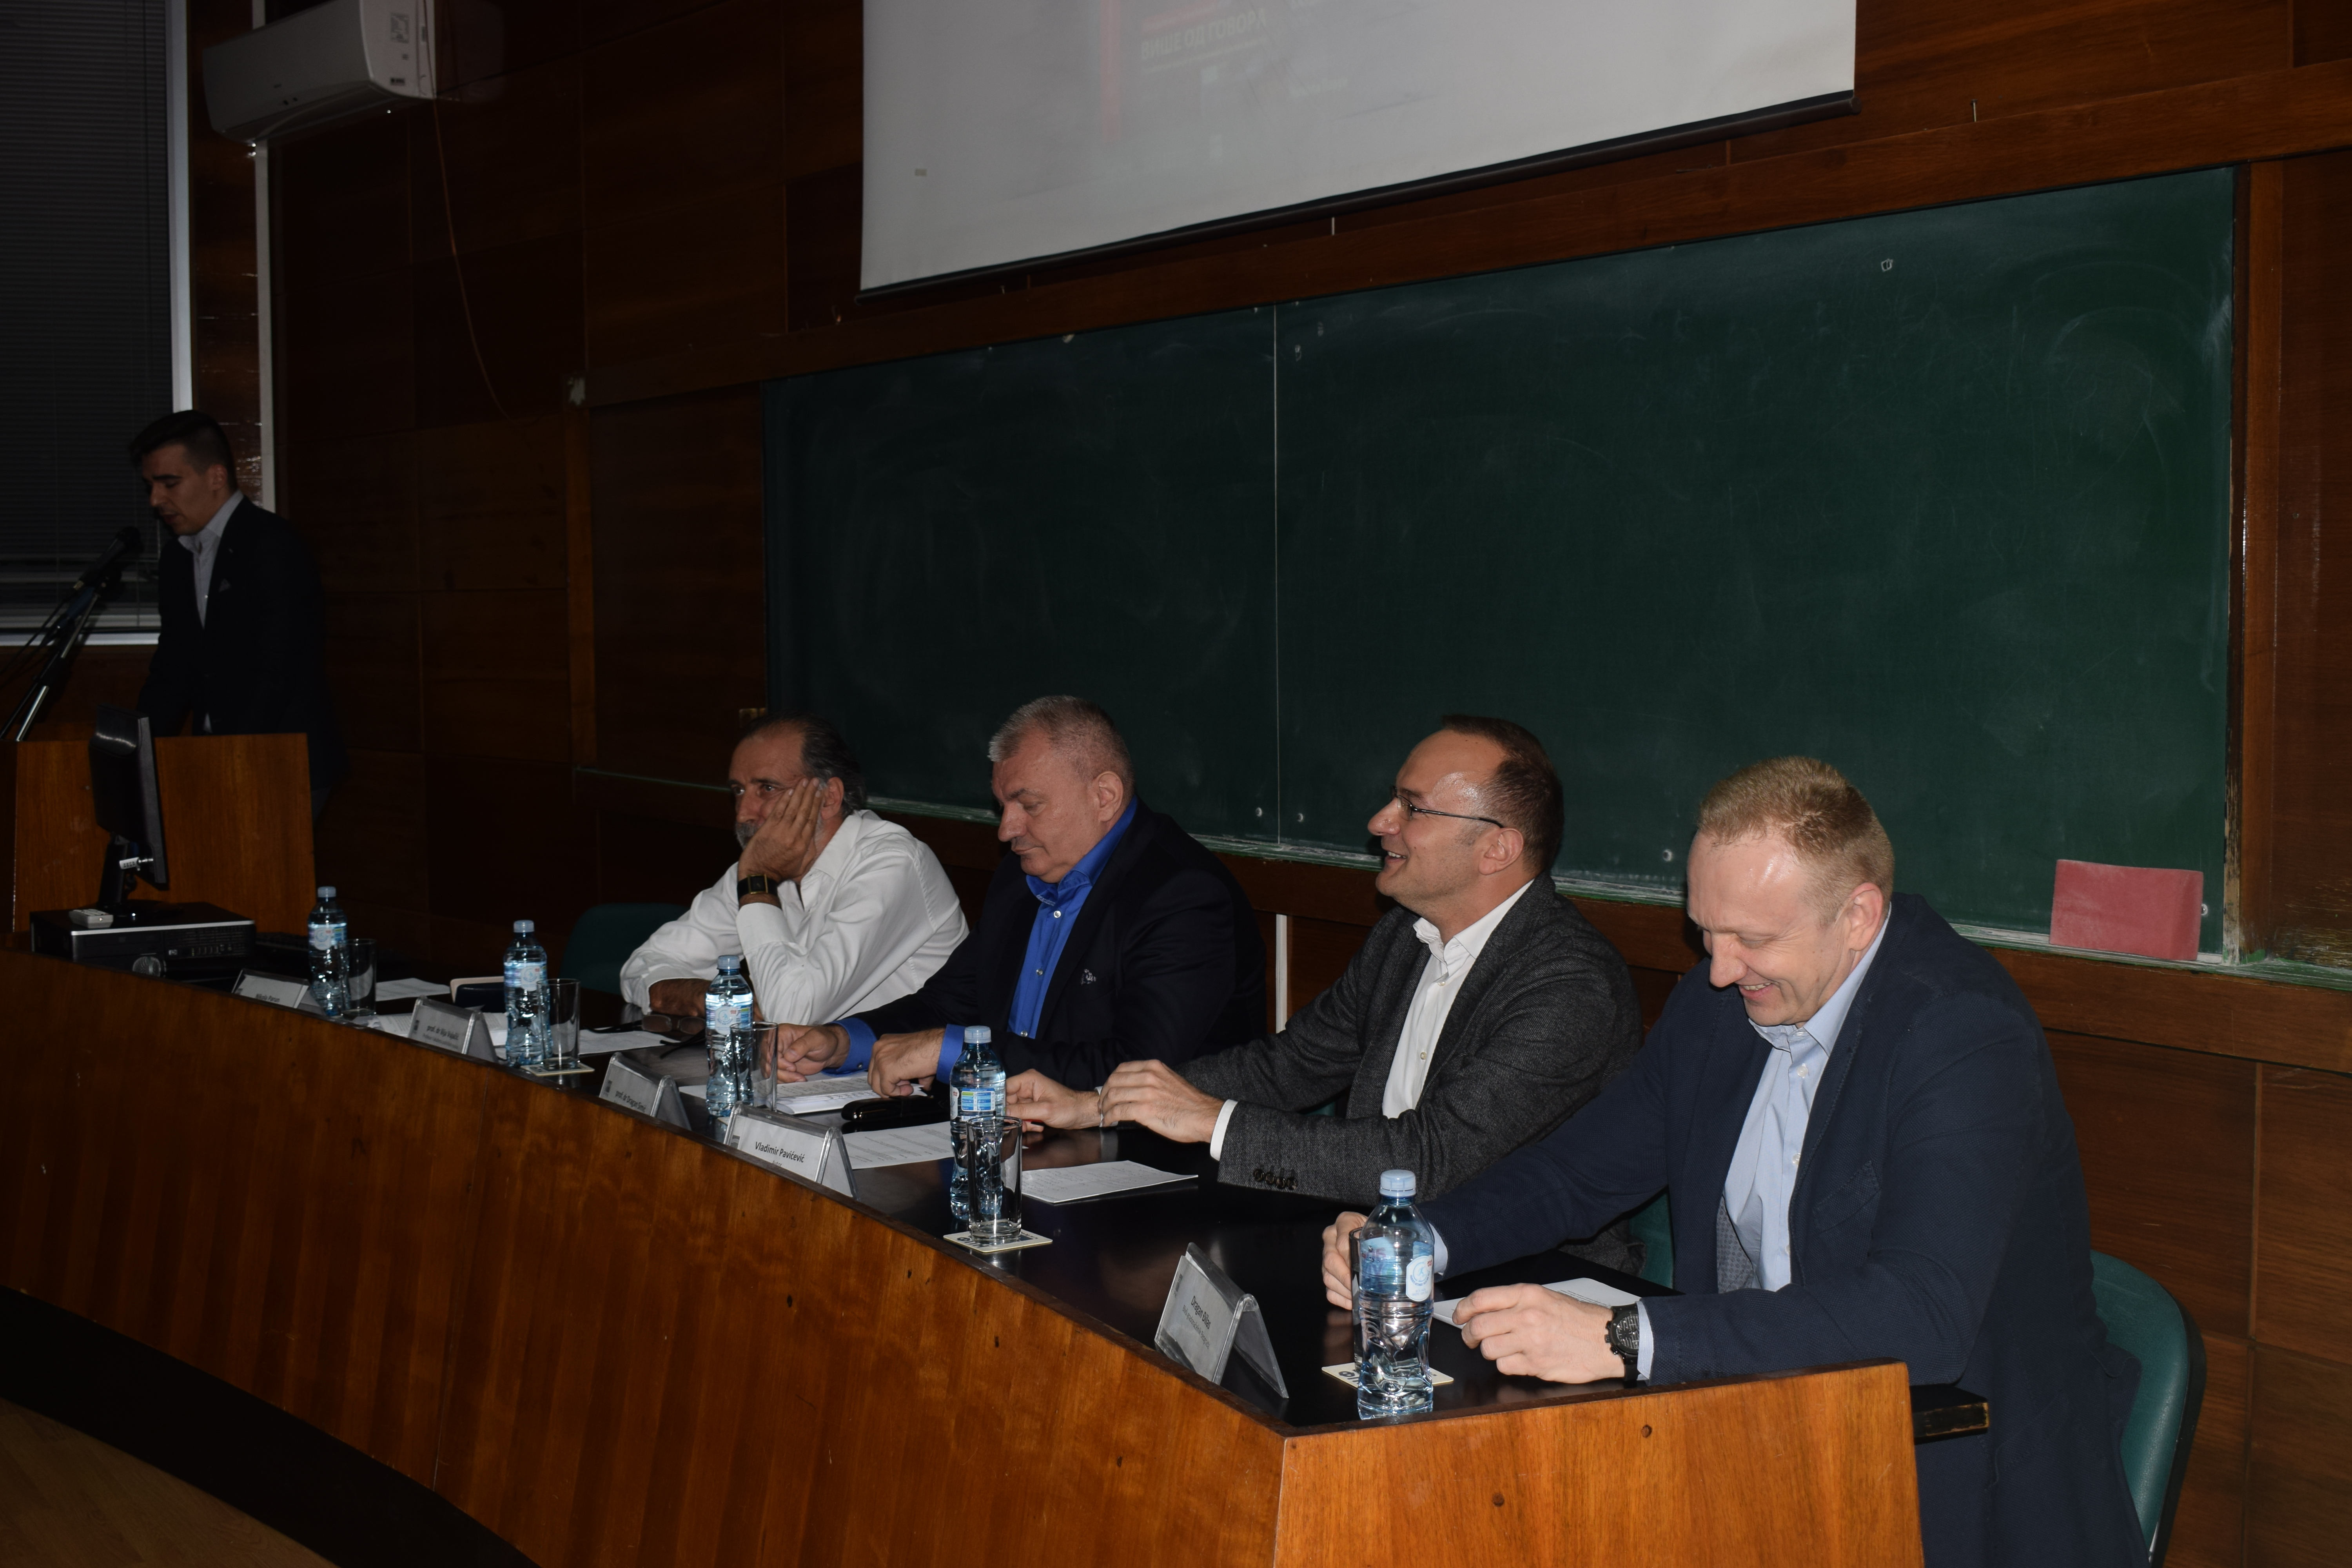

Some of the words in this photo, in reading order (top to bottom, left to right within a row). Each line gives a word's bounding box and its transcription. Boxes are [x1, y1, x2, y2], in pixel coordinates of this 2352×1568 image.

[1141, 31, 1182, 61] ВИШЕ
[1184, 25, 1205, 50] ОД
[1208, 7, 1267, 42] ГОВОРА
[755, 1141, 779, 1156] Vladimir
[779, 1148, 805, 1163] Pavićević
[1191, 1295, 1203, 1319] Dragan
